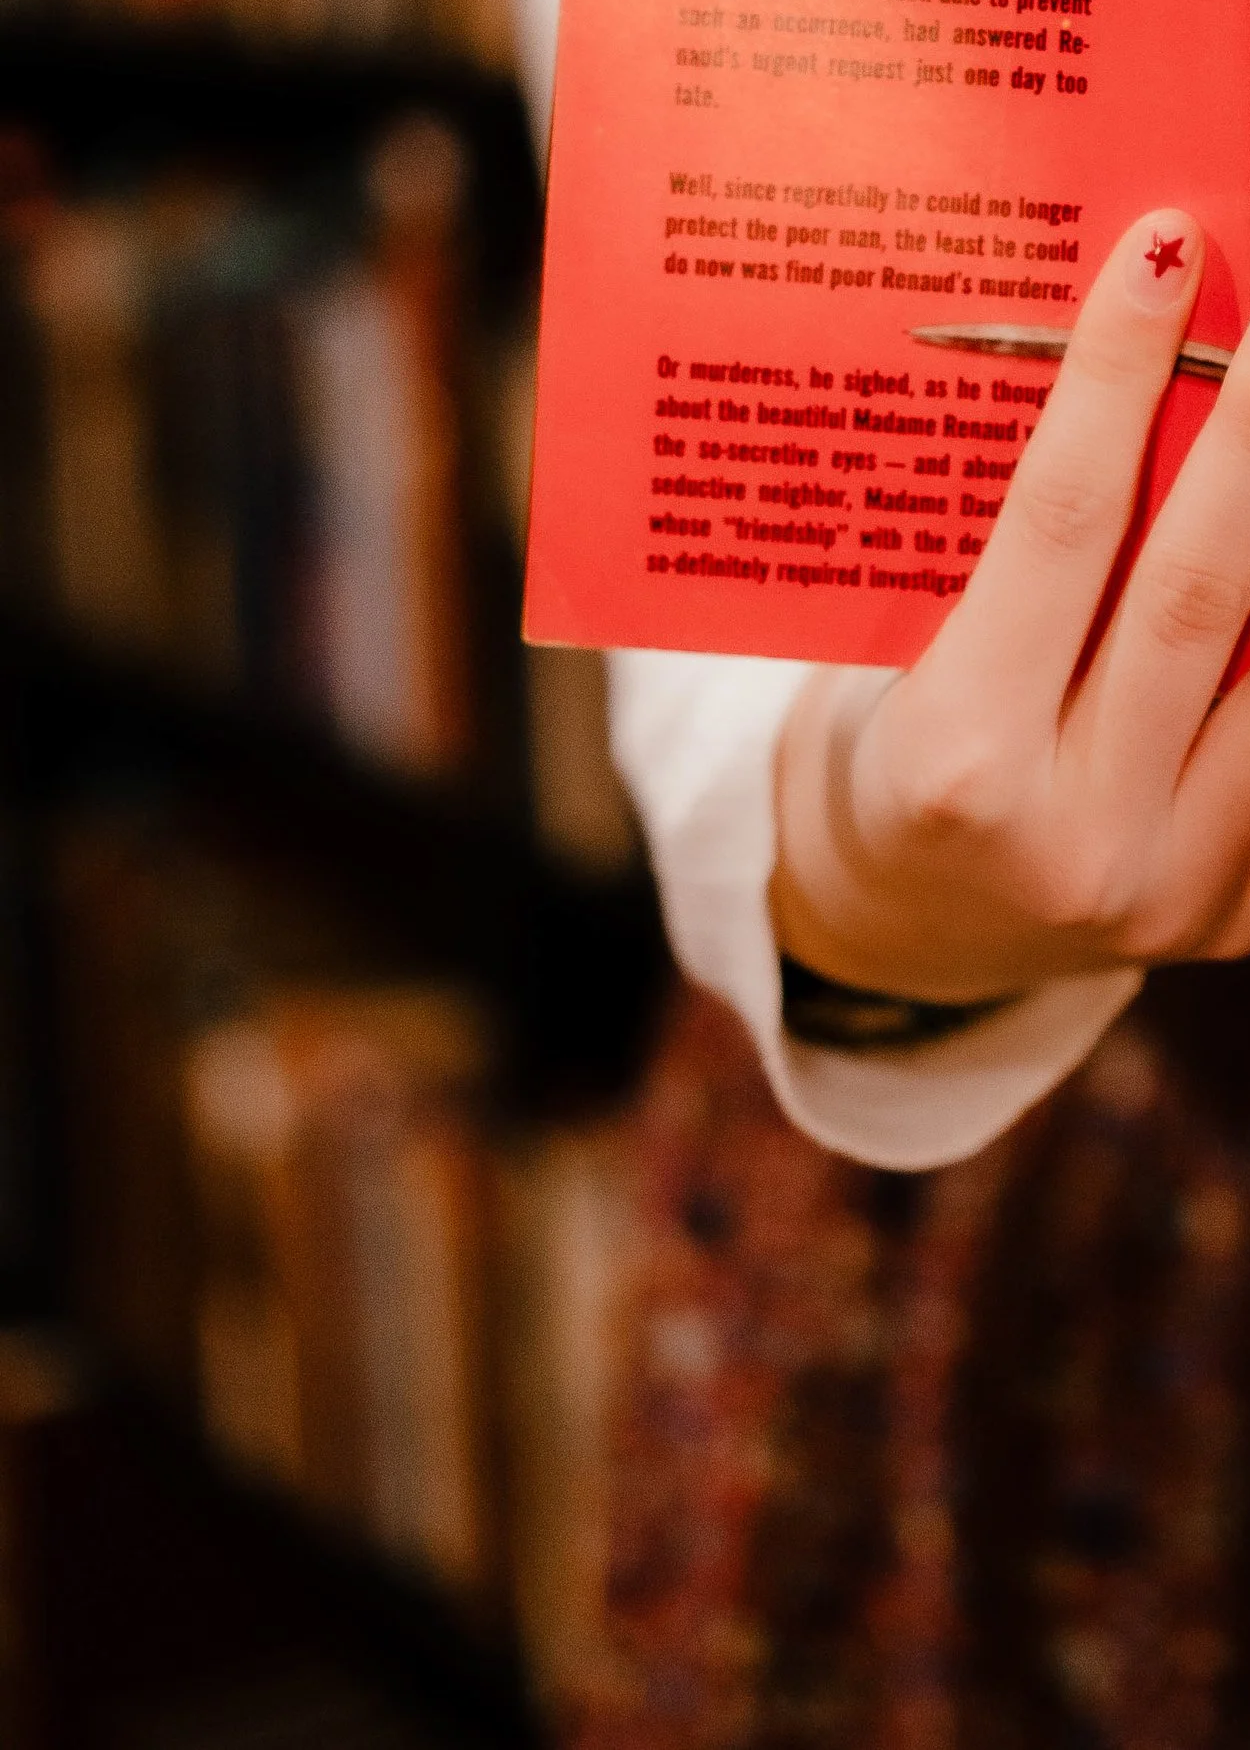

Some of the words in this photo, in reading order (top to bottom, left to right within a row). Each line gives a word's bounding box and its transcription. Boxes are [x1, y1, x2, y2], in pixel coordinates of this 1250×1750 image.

[902, 18, 939, 42] had
[952, 27, 1047, 51] answered
[1058, 29, 1091, 54] Re-
[914, 59, 952, 85] just
[963, 67, 1000, 87] one
[1009, 66, 1045, 94] day
[1055, 70, 1087, 94] too
[669, 173, 717, 201] Well,
[724, 181, 777, 201] since
[895, 187, 920, 211] he
[925, 193, 982, 216] could
[987, 198, 1012, 218] no
[1018, 197, 1082, 226] longer
[663, 215, 737, 239] protect
[745, 218, 777, 242] the
[784, 225, 829, 247] poor
[838, 229, 886, 251] man,
[893, 229, 926, 252] the
[934, 230, 984, 256] least
[992, 235, 1016, 258] he
[1023, 239, 1079, 263] could
[663, 252, 688, 275] do
[694, 258, 734, 277] now
[740, 262, 778, 281] was
[785, 259, 824, 285] find
[828, 267, 874, 290] poor
[880, 266, 972, 294] Renaud's
[978, 277, 1077, 301] murderer.
[656, 353, 680, 378] Or
[689, 361, 800, 387] murderess,
[809, 365, 834, 390] he
[844, 371, 914, 397] sighed,
[924, 379, 948, 398] as
[956, 376, 981, 400] he
[991, 377, 1053, 410] thoug
[654, 395, 712, 420] about
[717, 399, 750, 423] the
[756, 403, 846, 428] beautiful
[853, 409, 937, 435] Madame
[942, 414, 1018, 442] Renaud
[653, 433, 686, 457] the
[698, 441, 818, 466] so-secretive
[831, 451, 876, 472] eyes
[913, 453, 951, 476] and
[650, 475, 746, 500] seductive
[757, 482, 852, 511] neighbor,
[864, 488, 948, 514] Madame
[959, 491, 1005, 518] Dau
[649, 514, 712, 537] whose
[860, 529, 902, 550] with
[913, 530, 947, 554] the
[646, 552, 769, 582] so-definitely
[776, 563, 861, 587] required
[868, 568, 967, 596] investigat
